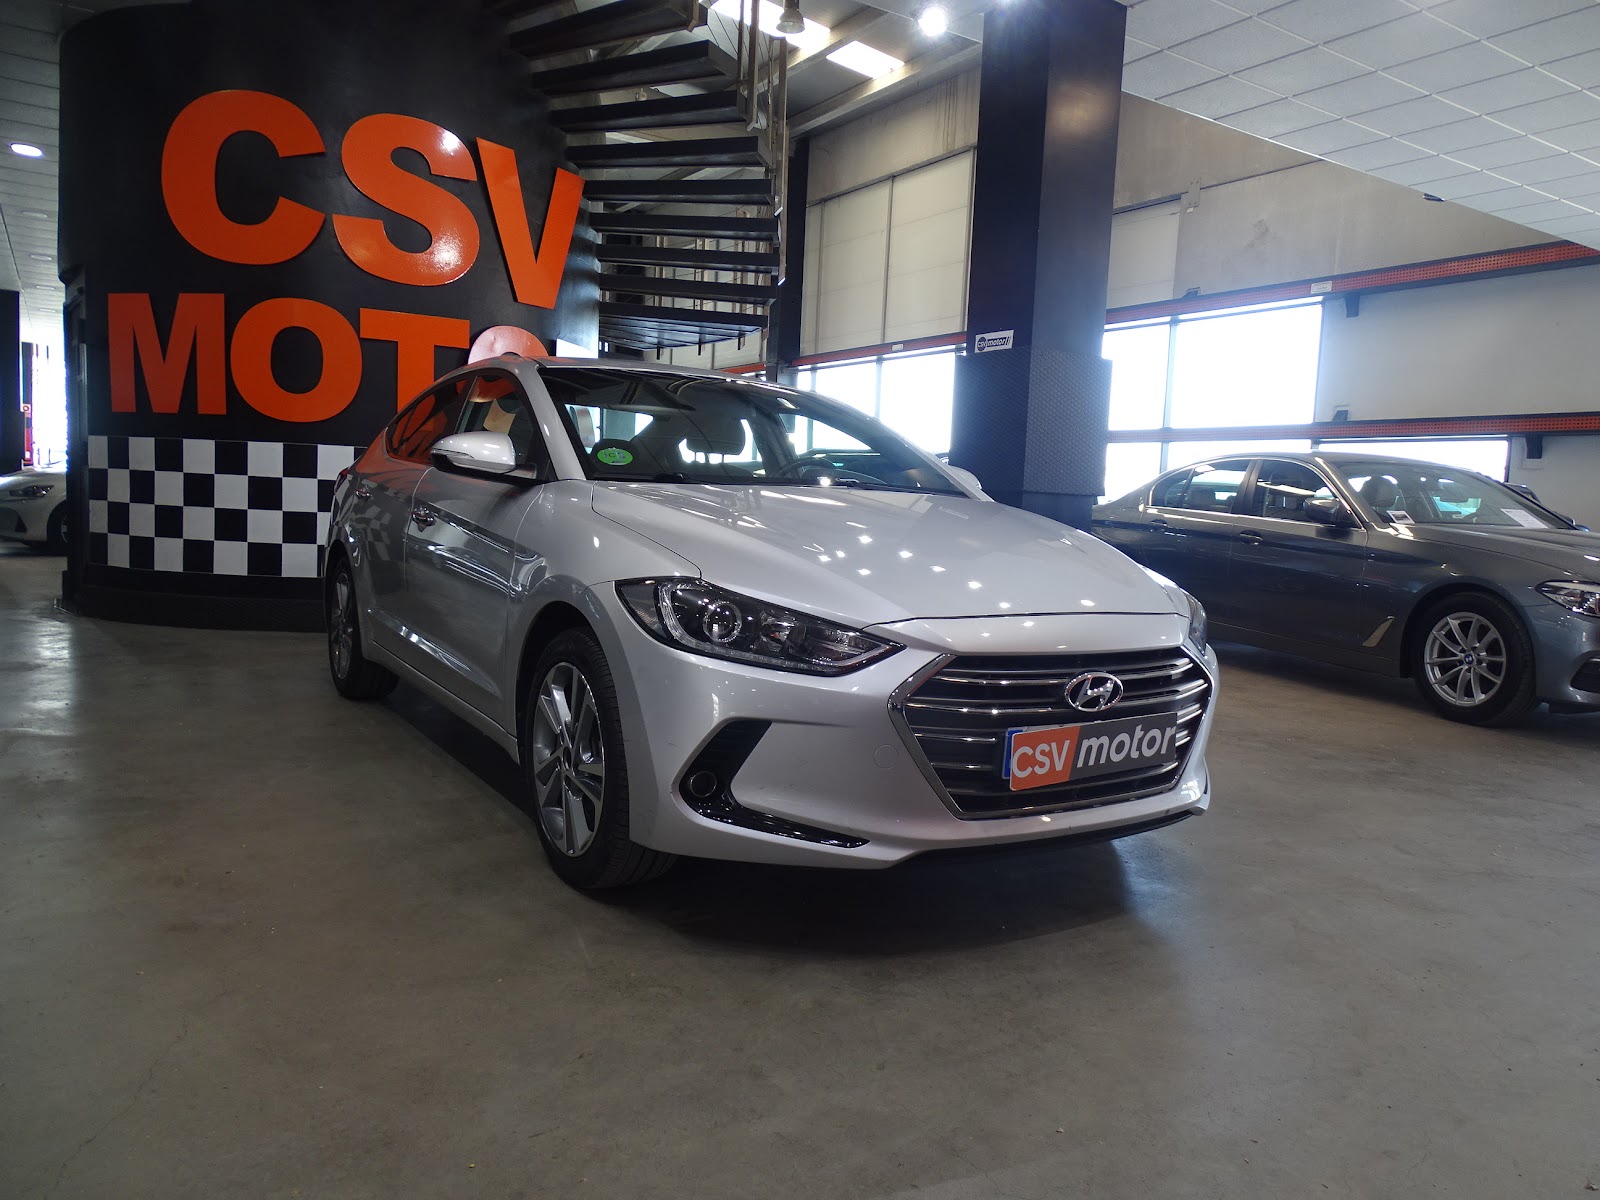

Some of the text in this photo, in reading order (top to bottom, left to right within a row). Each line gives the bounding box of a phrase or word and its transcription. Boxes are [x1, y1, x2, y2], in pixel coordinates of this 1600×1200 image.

[162, 90, 585, 309] CSV
[1013, 724, 1176, 778] CSV motor
